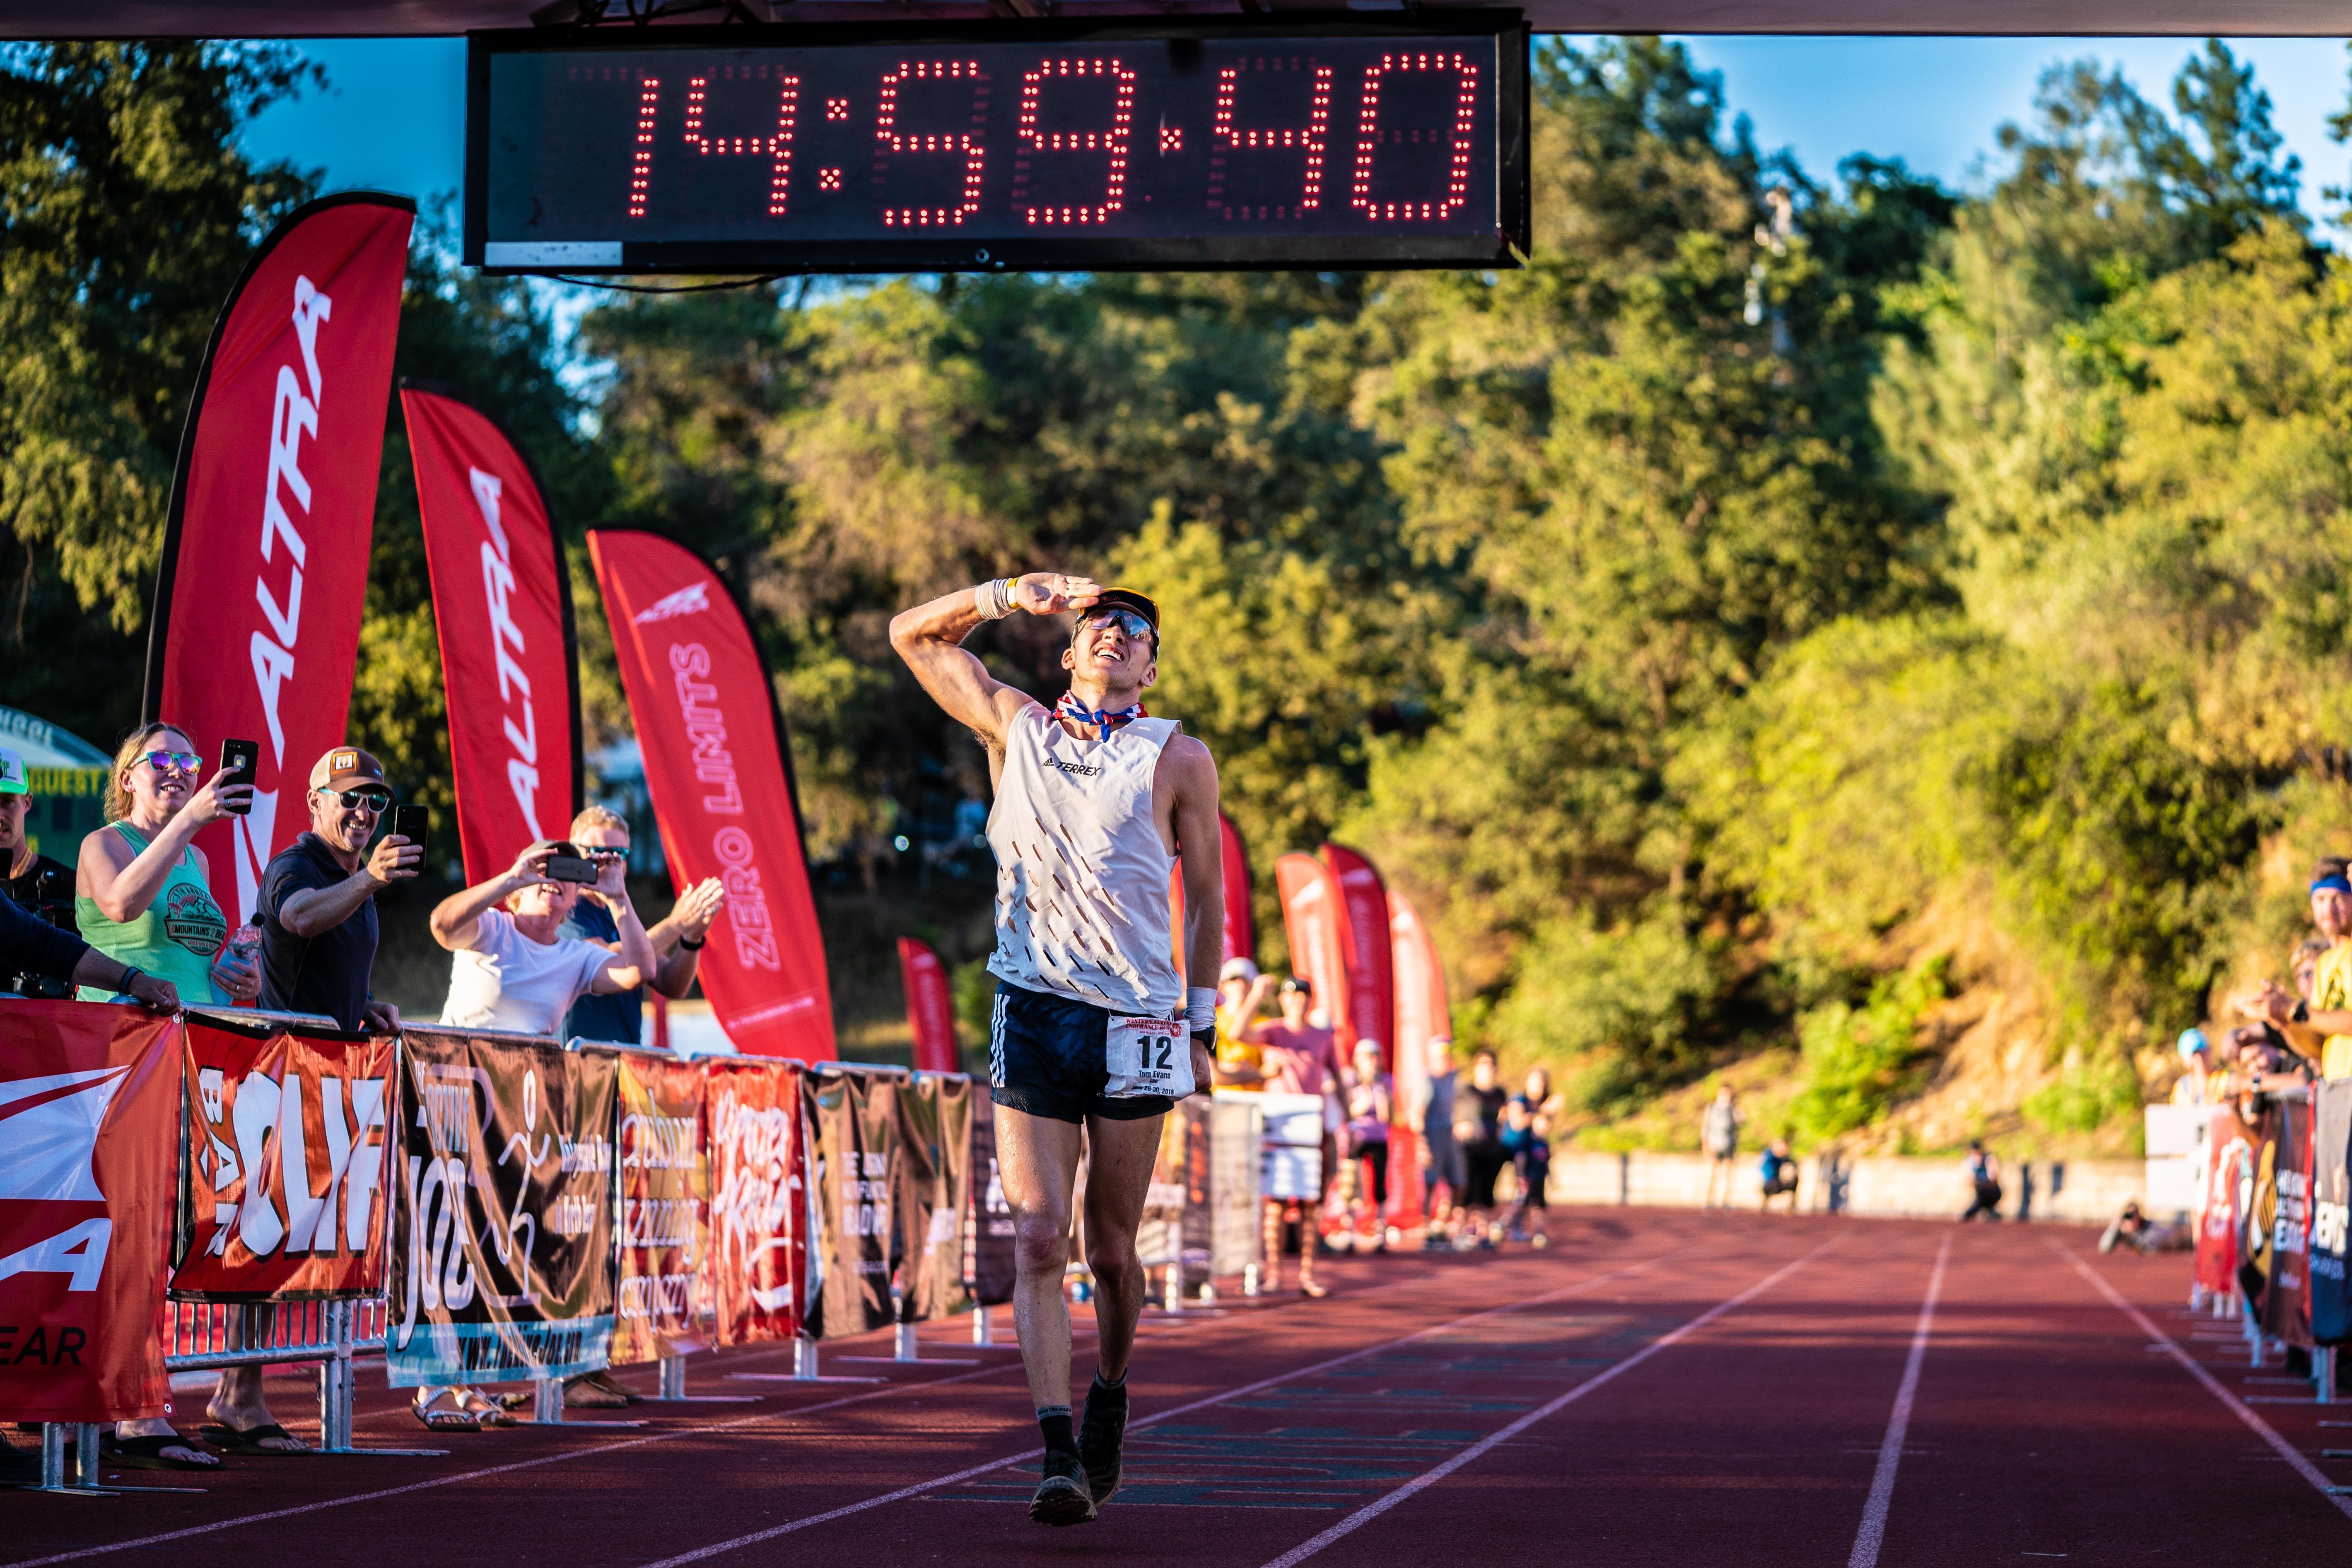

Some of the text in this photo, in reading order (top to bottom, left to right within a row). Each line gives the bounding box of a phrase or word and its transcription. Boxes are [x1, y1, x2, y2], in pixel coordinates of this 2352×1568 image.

[250, 274, 333, 772] ALTRA
[470, 466, 543, 842] ALTRA
[669, 643, 743, 815] LIMITS
[1056, 761, 1102, 776] TERREX
[174, 924, 210, 936] MOUNTAINS
[210, 928, 215, 938] 2
[713, 827, 781, 972] ZERO
[1137, 1035, 1173, 1070] 12
[1153, 1071, 1171, 1079] Evans
[198, 1065, 240, 1260] BAR
[232, 1070, 385, 1258] CLIF
